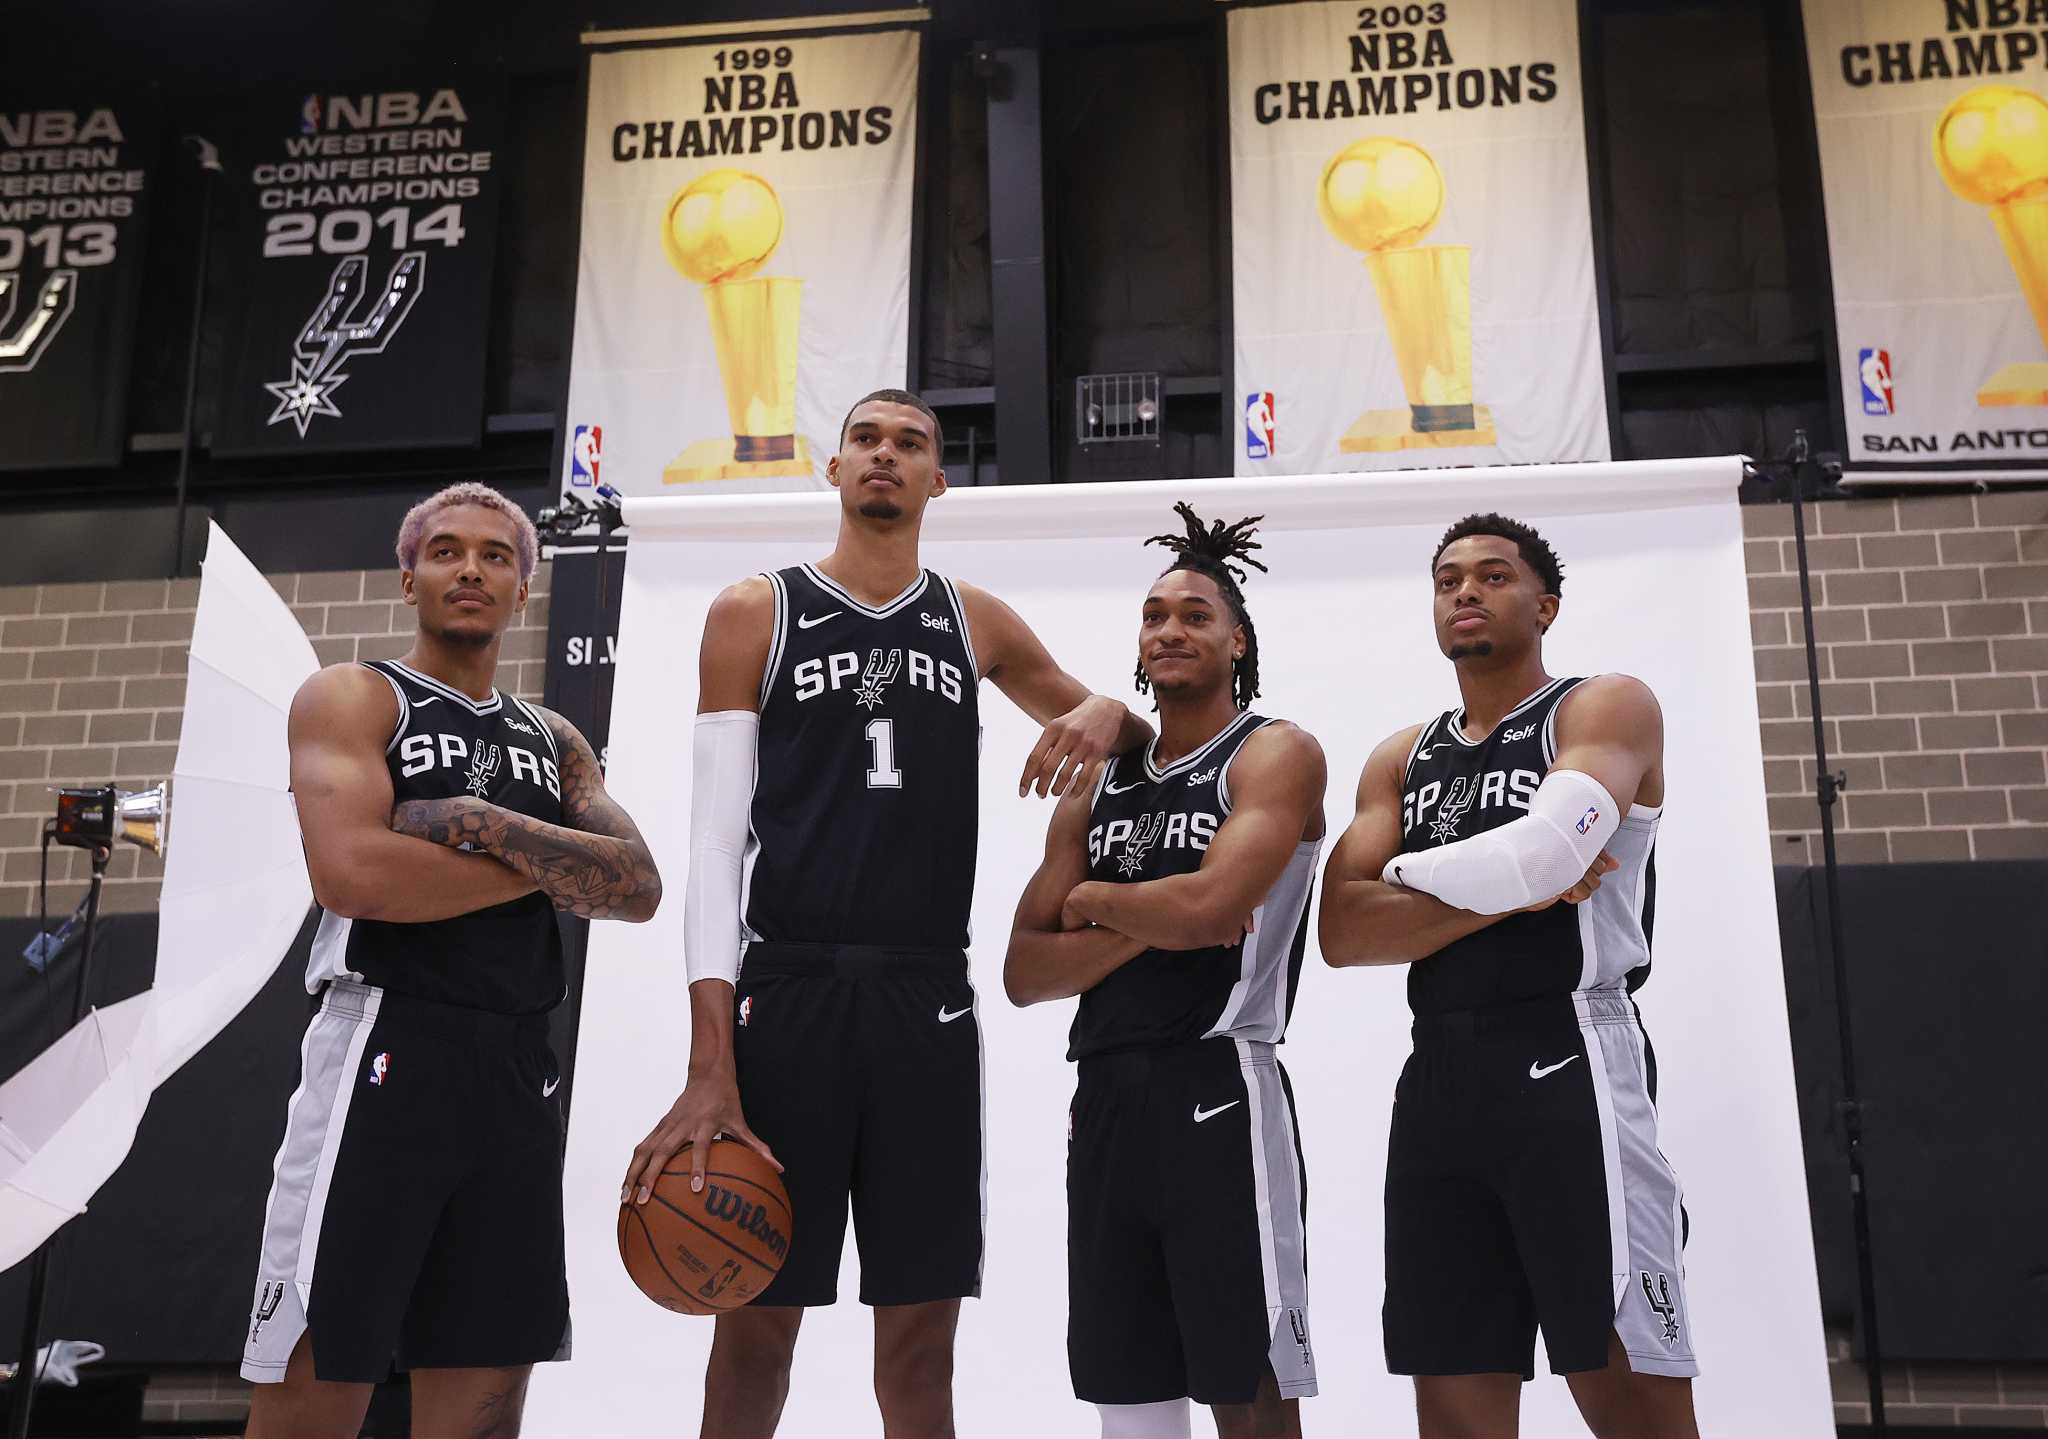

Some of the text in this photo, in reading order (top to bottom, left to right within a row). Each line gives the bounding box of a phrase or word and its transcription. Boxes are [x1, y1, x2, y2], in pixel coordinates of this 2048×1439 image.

[1358, 3, 1447, 29] 2003
[713, 46, 793, 71] 1999
[1349, 29, 1453, 73] NBA
[327, 90, 468, 130] NBA
[704, 72, 800, 112] NBA
[1254, 63, 1558, 125] CHAMPIONS
[0, 109, 124, 146] NBA
[286, 129, 462, 157] WESTERN
[613, 106, 892, 161] CHAMPIONS
[0, 171, 144, 196] ERENCE
[253, 152, 491, 185] CONFERENCE
[260, 178, 480, 210] CHAMPIONS
[263, 204, 465, 258] 2014
[1863, 434, 1938, 453] SAN
[794, 648, 963, 711] SPURS
[865, 719, 902, 789] 1
[705, 1184, 788, 1260] Wilson
